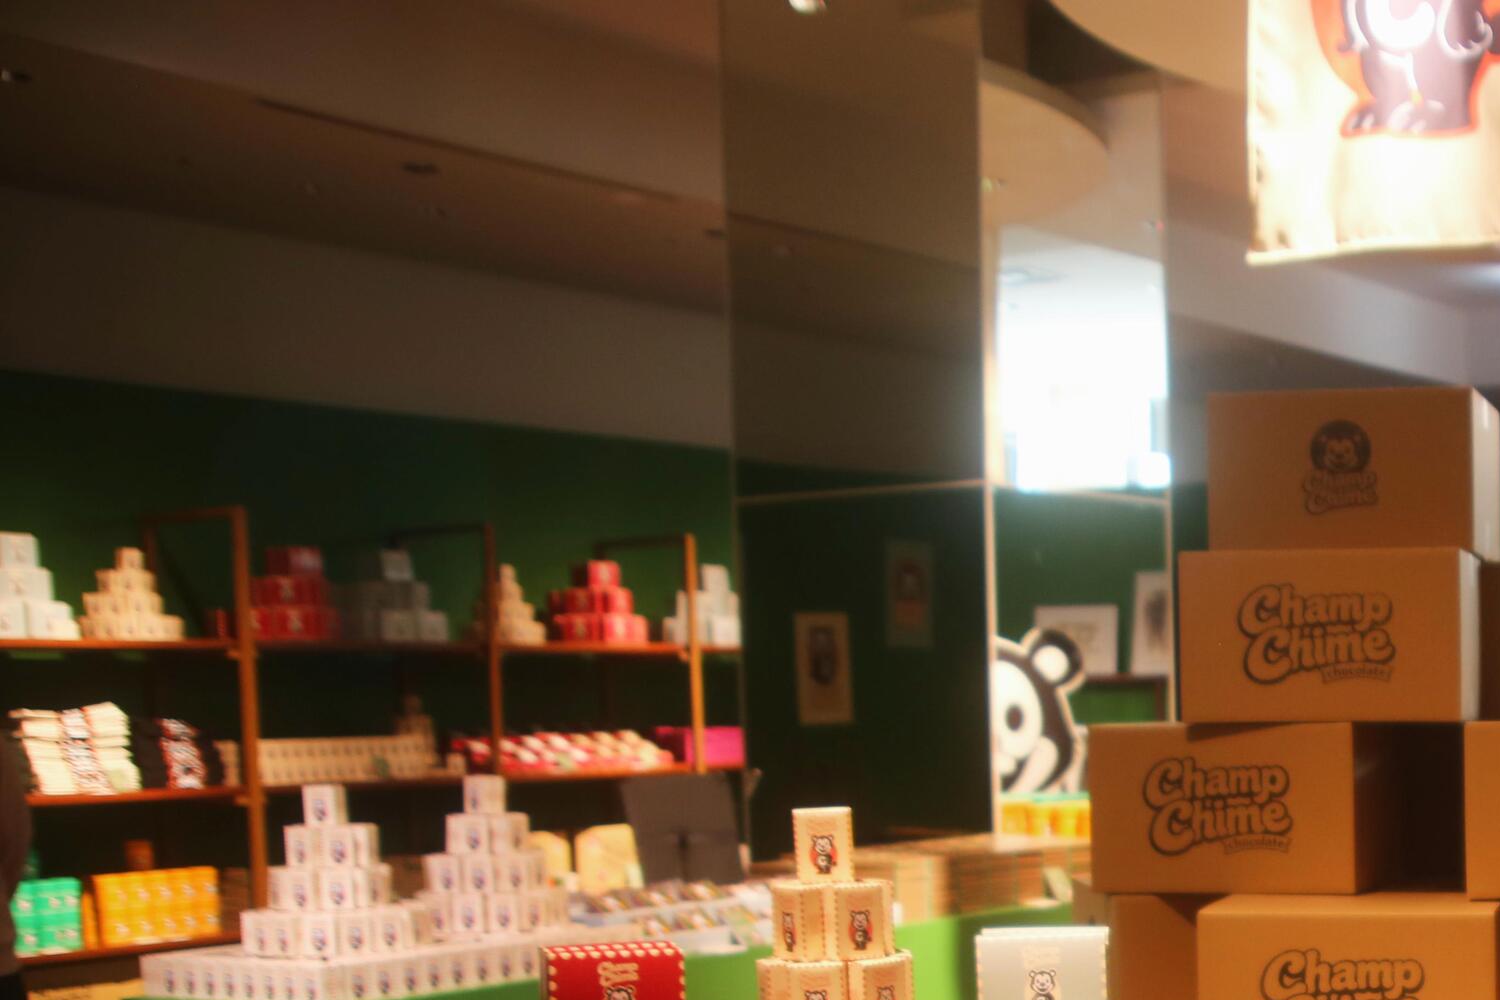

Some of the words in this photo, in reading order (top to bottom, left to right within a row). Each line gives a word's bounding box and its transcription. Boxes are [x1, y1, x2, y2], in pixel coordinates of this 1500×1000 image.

[1237, 583, 1394, 639] Champ
[1243, 625, 1396, 685] Chime
[1143, 757, 1290, 811] Champ
[1149, 798, 1293, 856] Chime
